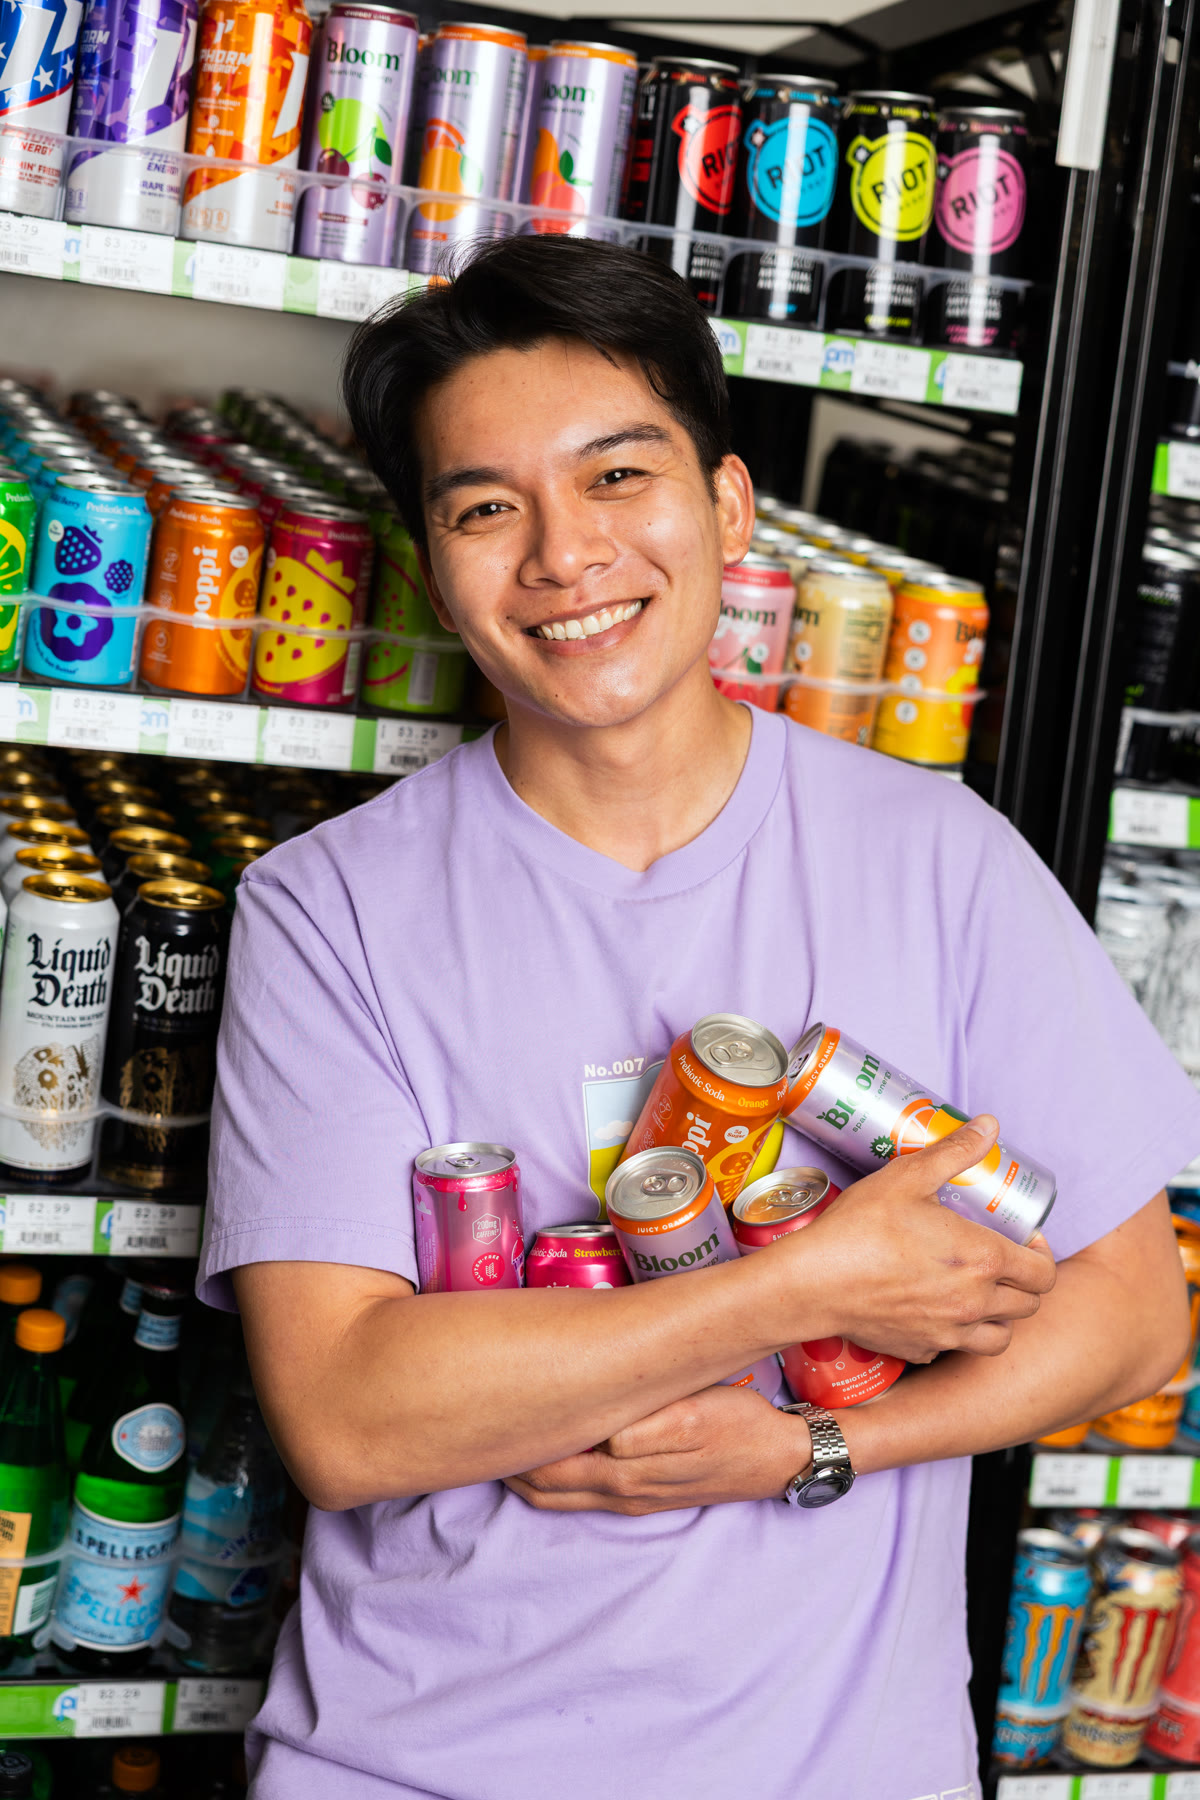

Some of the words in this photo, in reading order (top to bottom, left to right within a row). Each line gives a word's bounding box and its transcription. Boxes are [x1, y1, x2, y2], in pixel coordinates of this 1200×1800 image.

[326, 39, 400, 72] Bloom
[543, 79, 595, 102] loom
[14, 140, 54, 157] NERGY
[702, 141, 735, 179] RIO
[140, 179, 165, 193] RAPE
[950, 174, 1010, 220] RIOT
[191, 544, 222, 630] poppi
[720, 600, 777, 627] loom
[26, 933, 112, 982] Liquid
[134, 935, 220, 988] Liquid
[28, 970, 108, 1009] Death
[134, 972, 216, 1015] Death
[26, 1010, 77, 1023] MOUNTAIN
[583, 1057, 646, 1078] No.007
[803, 1070, 820, 1091] JUICY
[817, 1040, 836, 1070] ORANGE
[678, 1053, 705, 1089] Prebiotic
[702, 1082, 725, 1102] Soda
[737, 1097, 769, 1109] Orange
[681, 1111, 712, 1160] ppi
[726, 1132, 746, 1140] Sugar
[1006, 1166, 1017, 1184] DRINK
[476, 1220, 498, 1231] 200mg
[637, 1226, 659, 1234] JUICY
[661, 1211, 695, 1231] ORANGE
[547, 1248, 568, 1258] Soda
[631, 1232, 721, 1272] Bloom
[473, 1254, 500, 1282] GLUTEN-FREE
[831, 1371, 868, 1388] PREBIOTIC
[867, 1360, 885, 1374] SODA
[842, 1372, 881, 1392] caffeine-free
